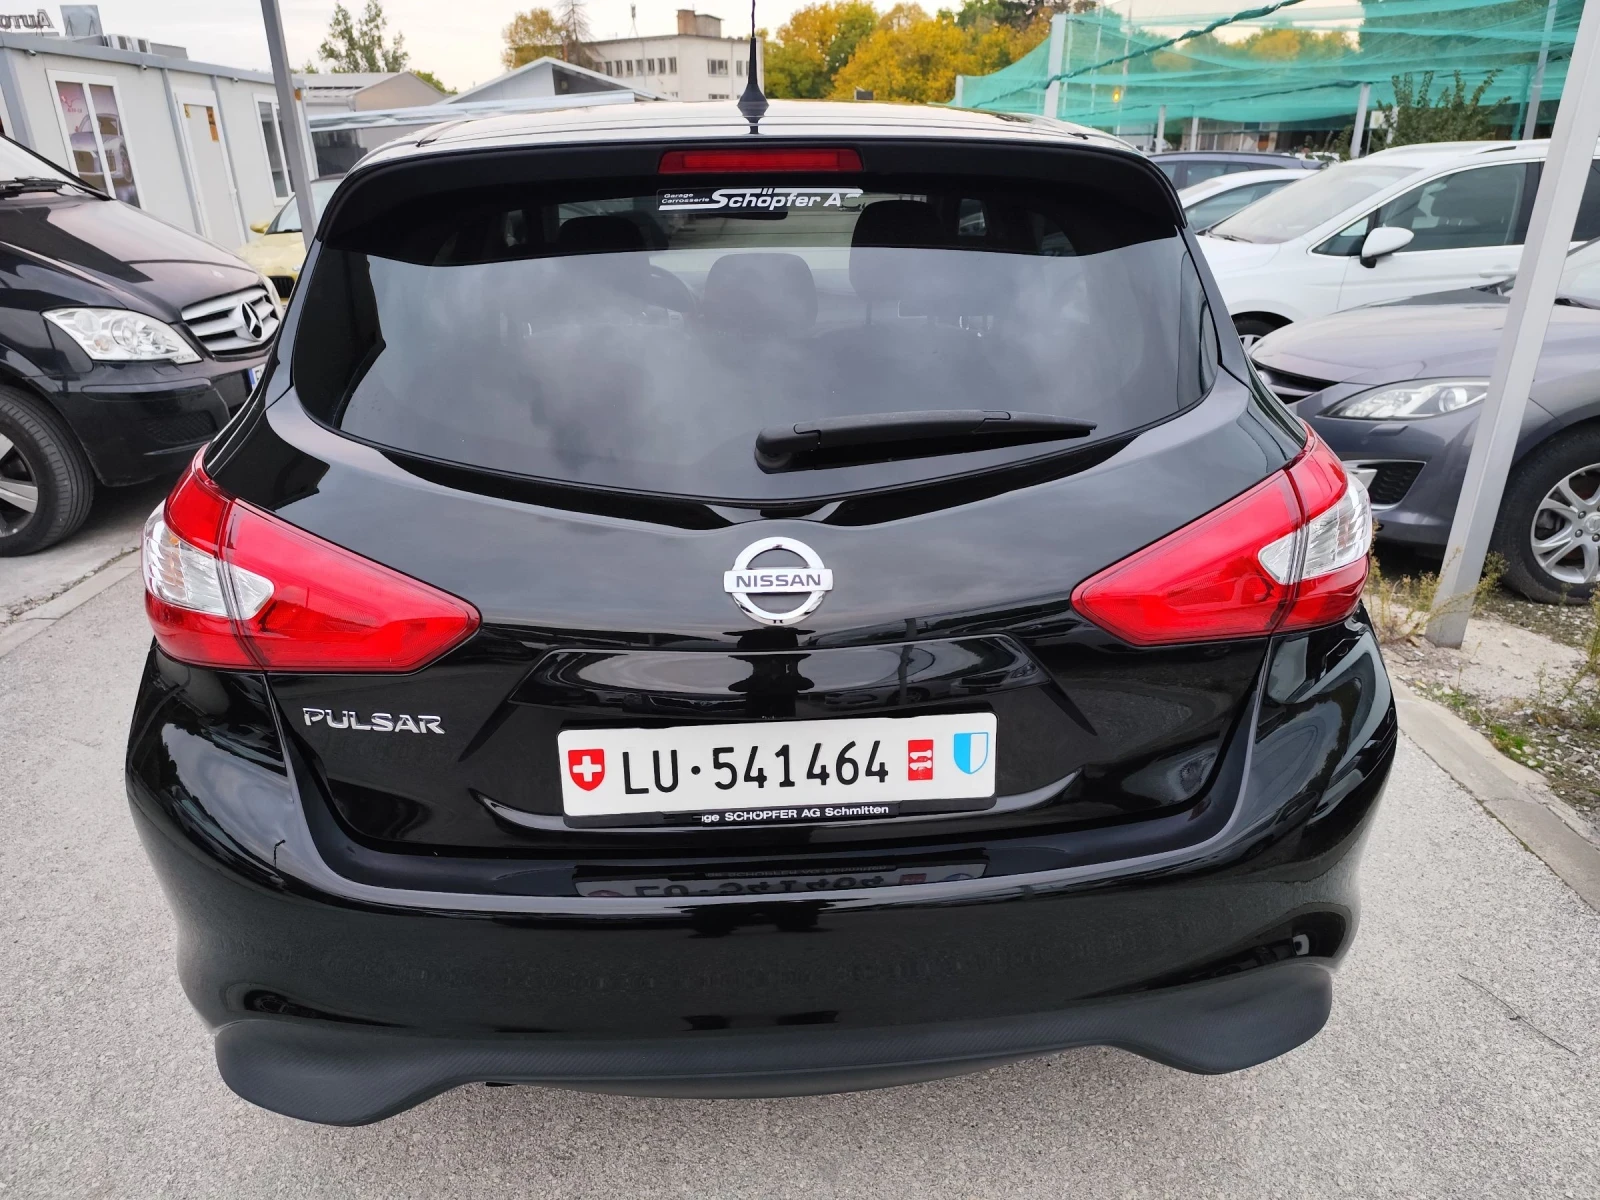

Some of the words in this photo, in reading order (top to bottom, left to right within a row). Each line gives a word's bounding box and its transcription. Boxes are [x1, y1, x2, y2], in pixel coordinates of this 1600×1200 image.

[711, 187, 821, 211] Schöpfer
[736, 574, 822, 588] NISSAN
[302, 707, 446, 735] PULSAR
[724, 809, 798, 822] SCHÖPFER
[801, 807, 821, 818] AG
[824, 805, 889, 817] Schmitten
